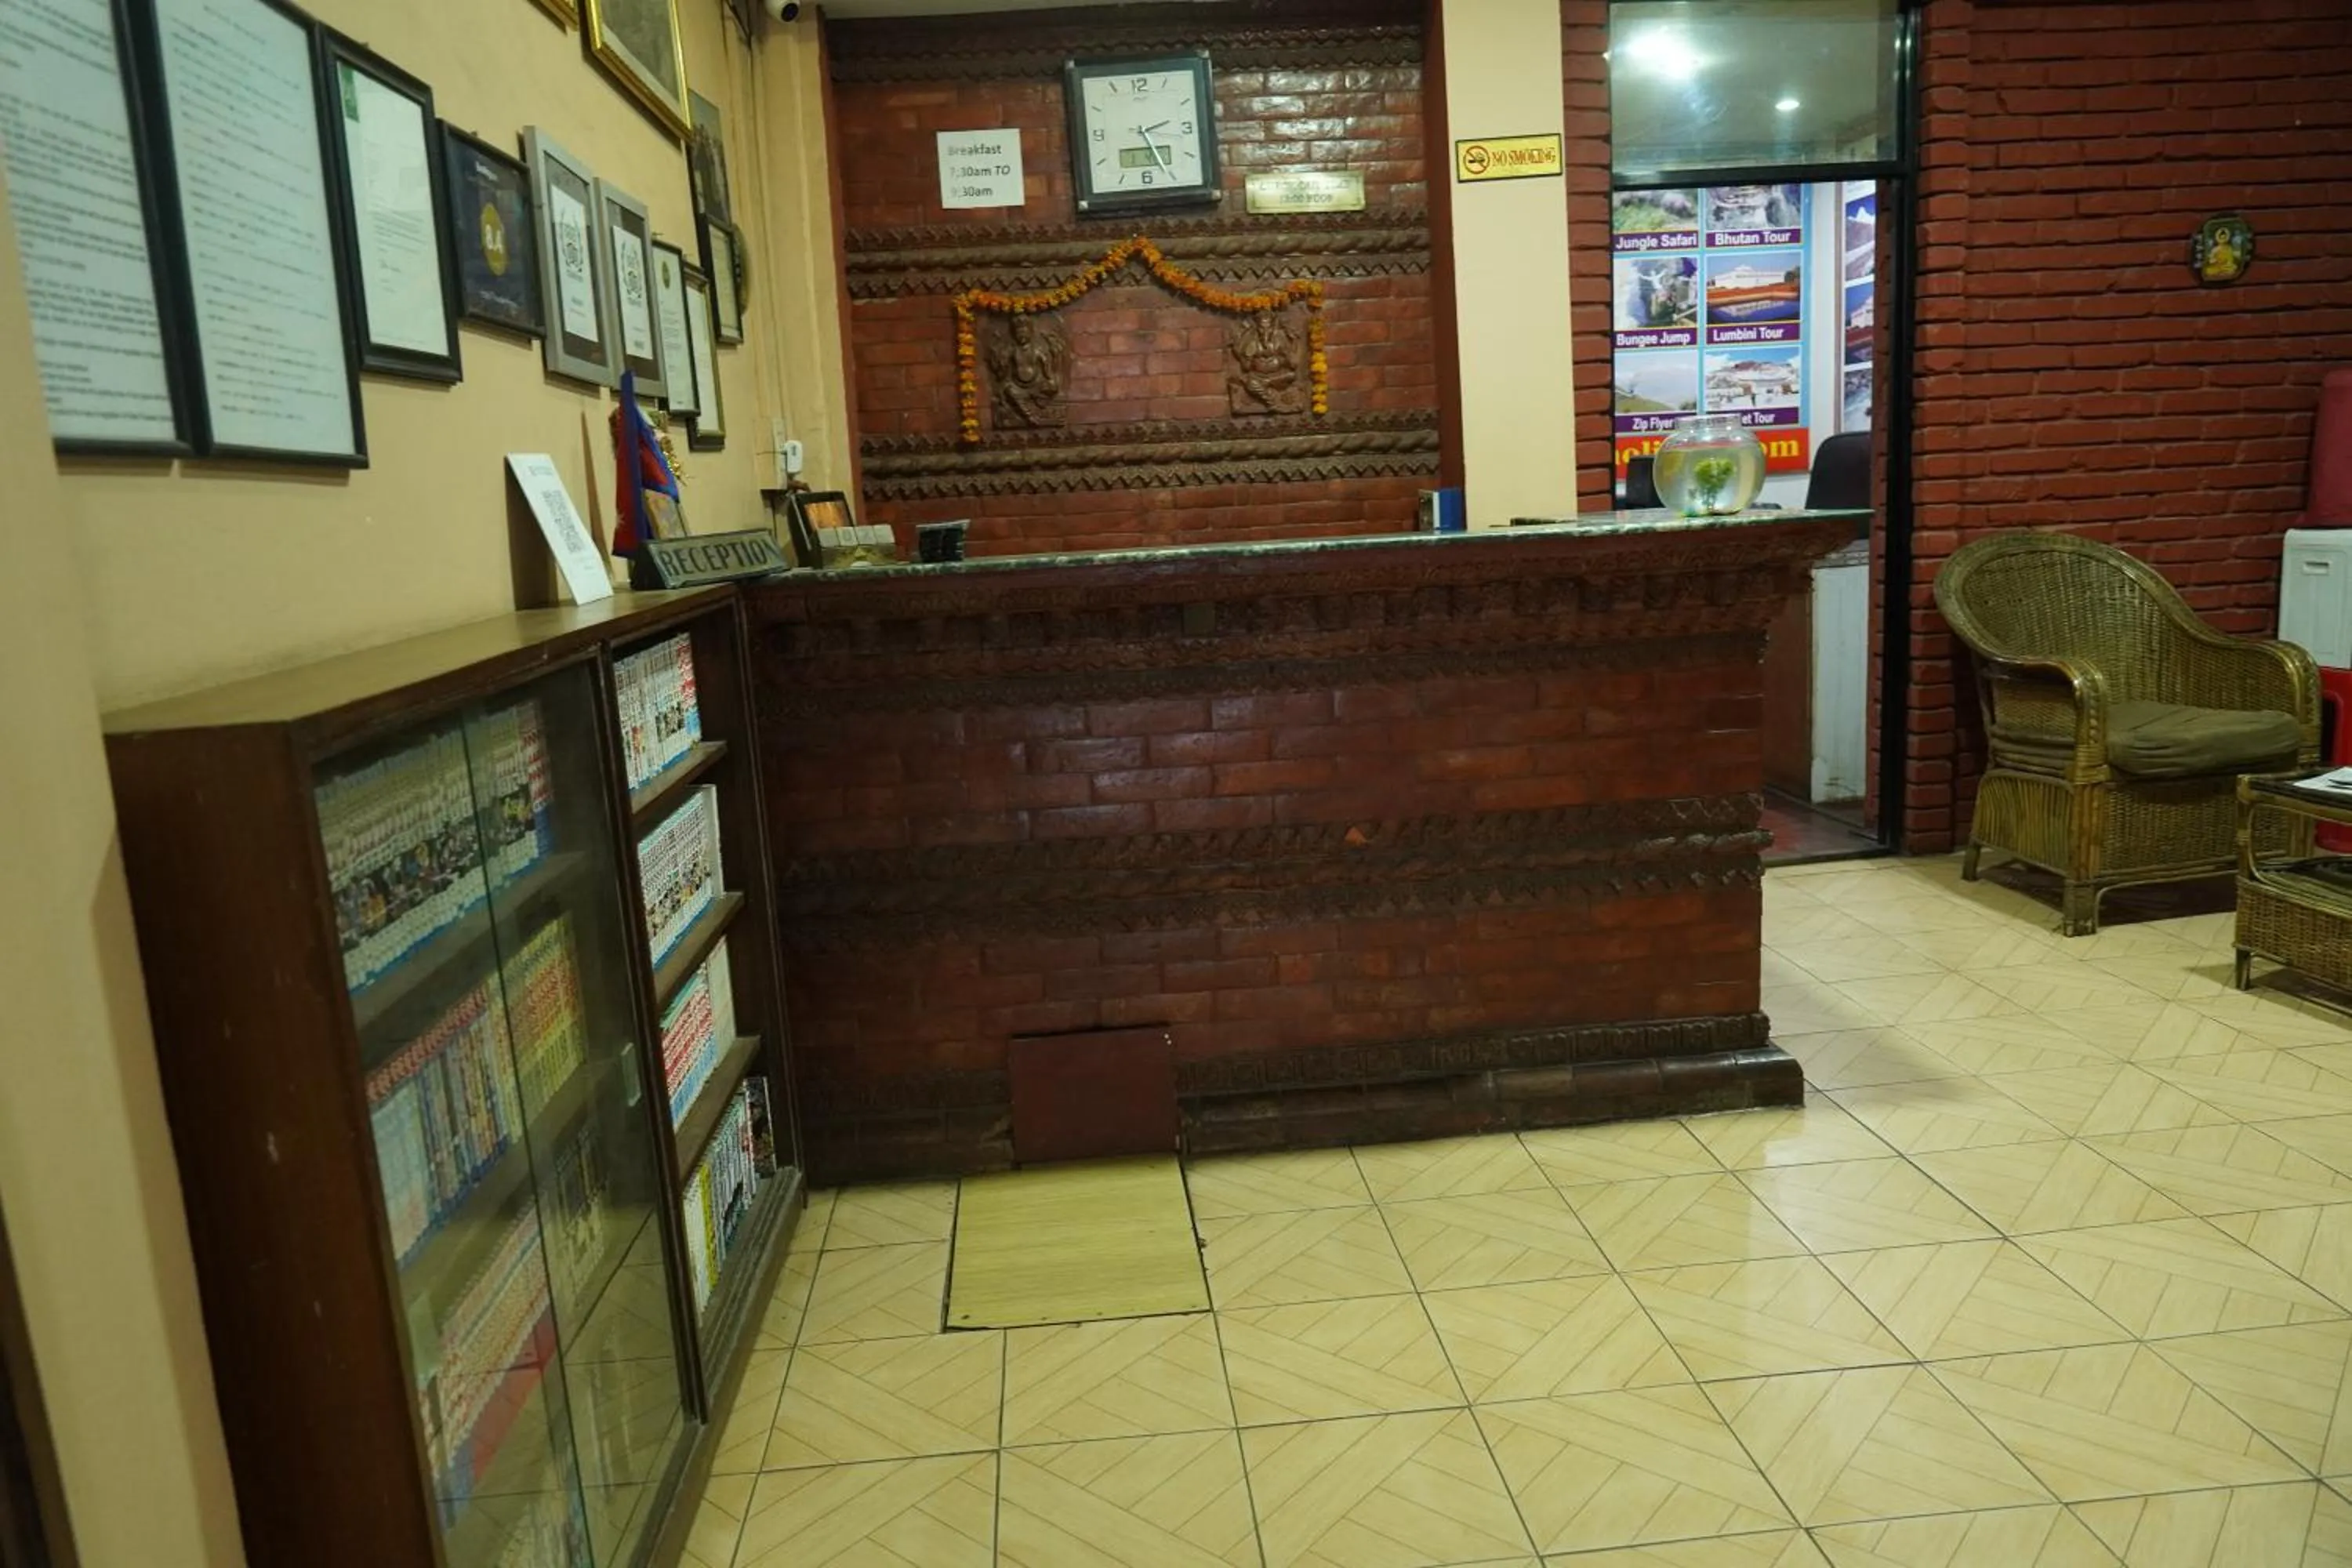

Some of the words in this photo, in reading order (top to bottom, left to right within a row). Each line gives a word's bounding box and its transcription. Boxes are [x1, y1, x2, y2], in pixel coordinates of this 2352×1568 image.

[1131, 78, 1148, 94] 12
[1181, 121, 1192, 135] 3
[1093, 129, 1105, 142] 9
[948, 143, 1002, 156] Breakfast
[1492, 150, 1508, 166] NO
[1508, 147, 1556, 165] SMOKING
[994, 164, 1011, 176] TO
[1142, 171, 1153, 184] 6
[1616, 235, 1658, 252] Jungle
[1660, 233, 1697, 247] Safari
[1715, 233, 1760, 245] Bhutan
[1762, 231, 1791, 243] Tour
[1616, 333, 1658, 347] Bungee
[1660, 332, 1691, 345] Jump
[1713, 328, 1757, 342] Lumbini
[1759, 327, 1784, 339] Tour
[1632, 417, 1648, 433] Zip
[1650, 416, 1674, 431] Flyer
[1753, 412, 1776, 424] Tour
[658, 539, 780, 577] RECEPTION
